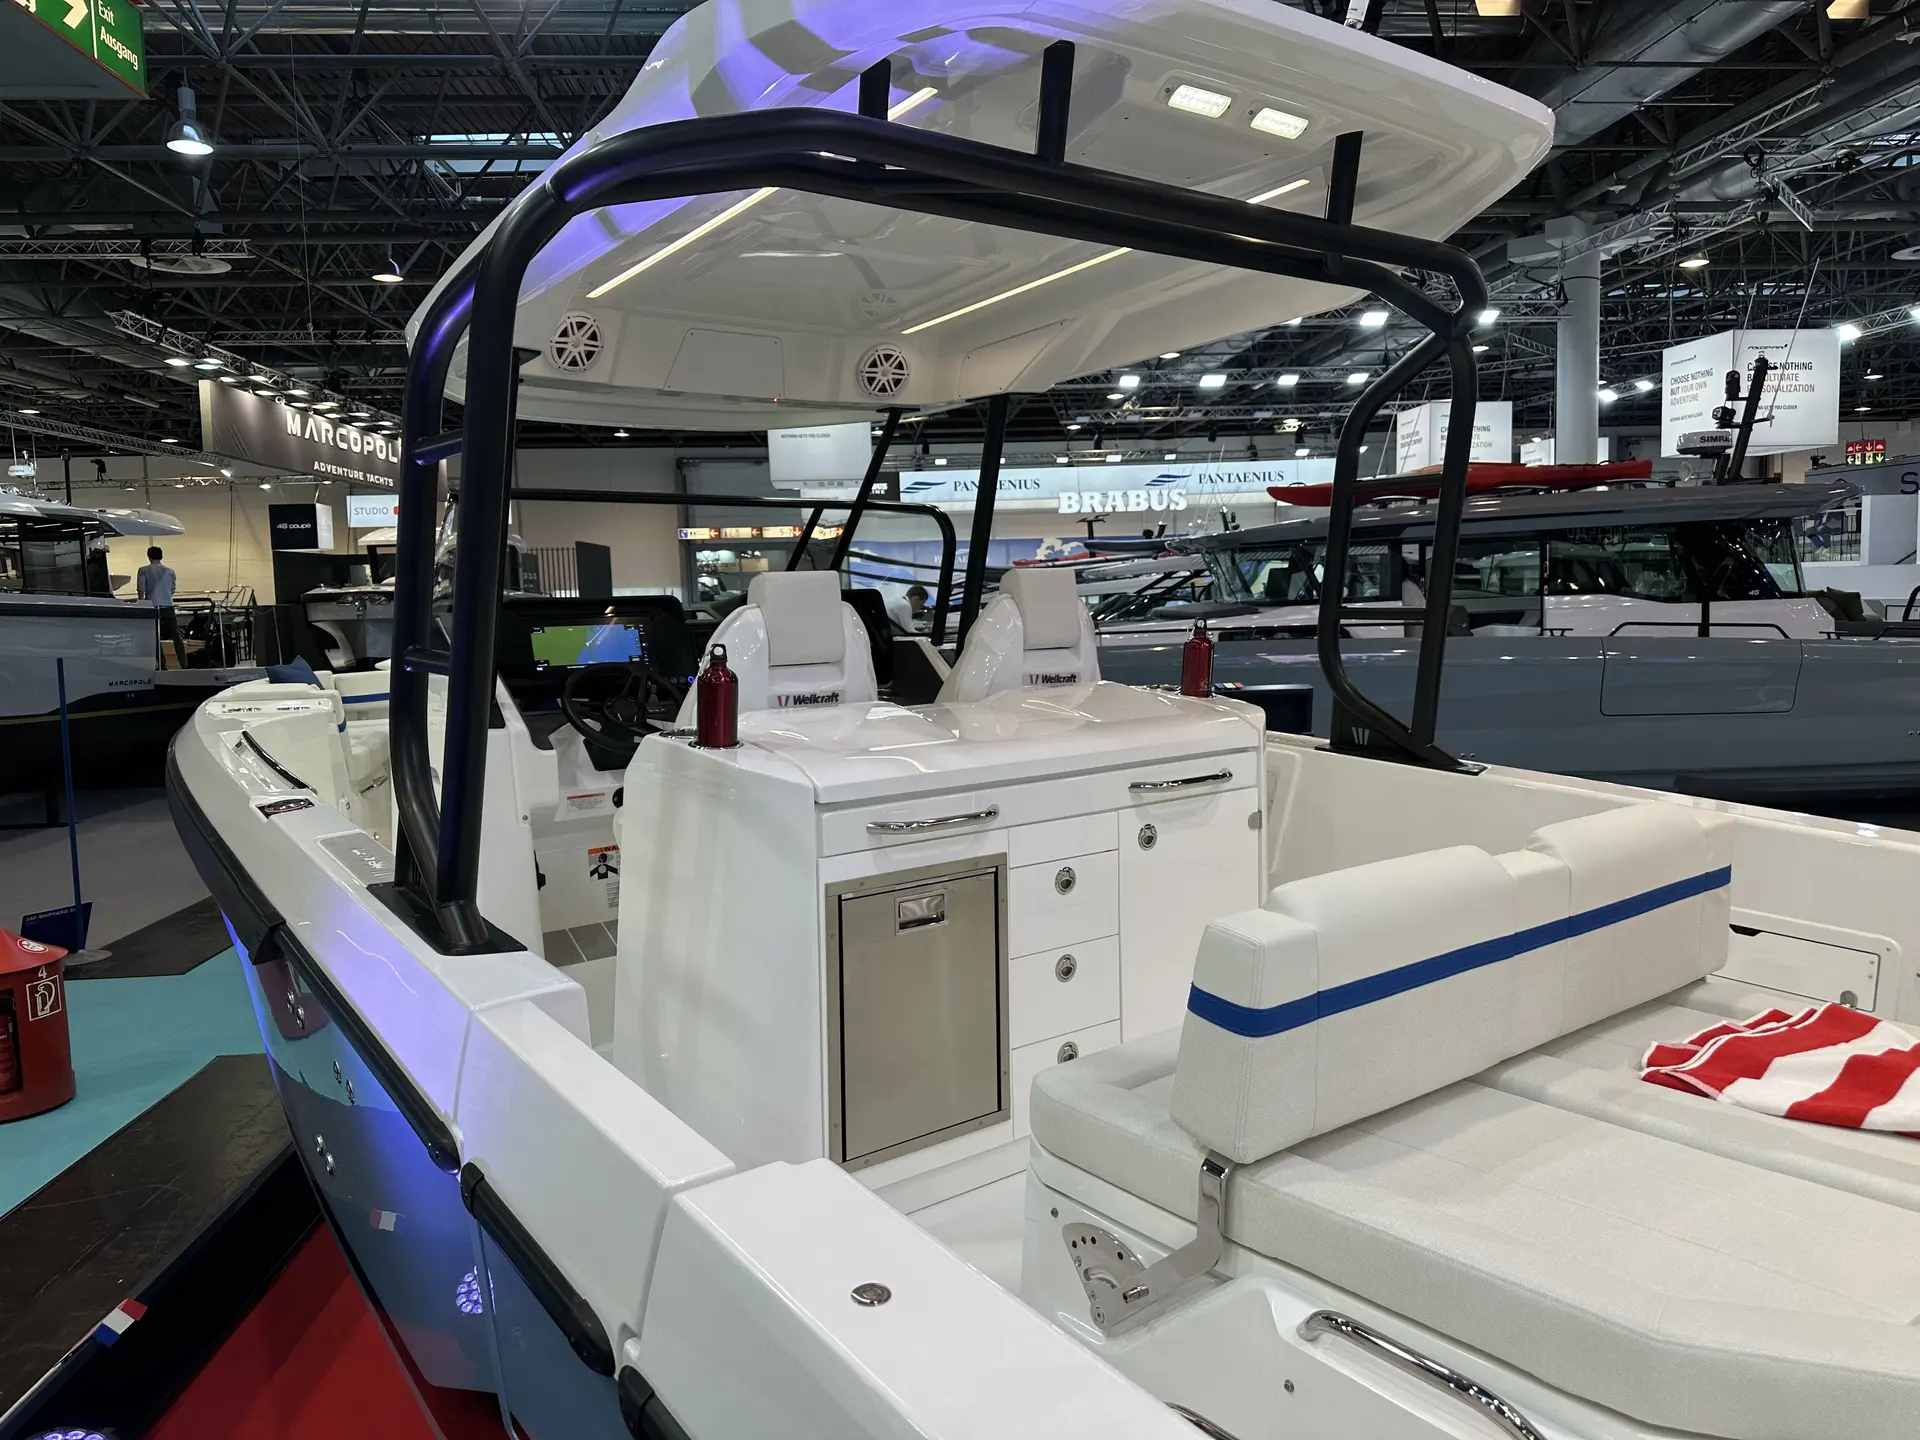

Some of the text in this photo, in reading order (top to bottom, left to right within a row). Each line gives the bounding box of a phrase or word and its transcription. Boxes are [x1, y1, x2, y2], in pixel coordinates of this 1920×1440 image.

[97, 0, 115, 26] Exit
[100, 26, 139, 70] Ausgang
[1779, 361, 1813, 371] NOTHING
[1670, 367, 1714, 386] CHOOSE NOTHING
[1670, 381, 1708, 397] BUT YOUR OWN
[1670, 393, 1699, 407] ADVENTURE
[285, 410, 402, 464] MARCOPOL
[1700, 435, 1732, 443] SIMRA
[313, 460, 394, 487] ADVENTURE YACHTS
[1198, 471, 1284, 484] PANTAENIUS
[1058, 488, 1188, 513] BRABUS
[354, 507, 389, 516] STUDIO
[108, 678, 152, 687] MARCOPOLO
[1040, 672, 1077, 685] Wellcraft
[792, 691, 839, 706] Wellcraft
[37, 964, 47, 979] 4
